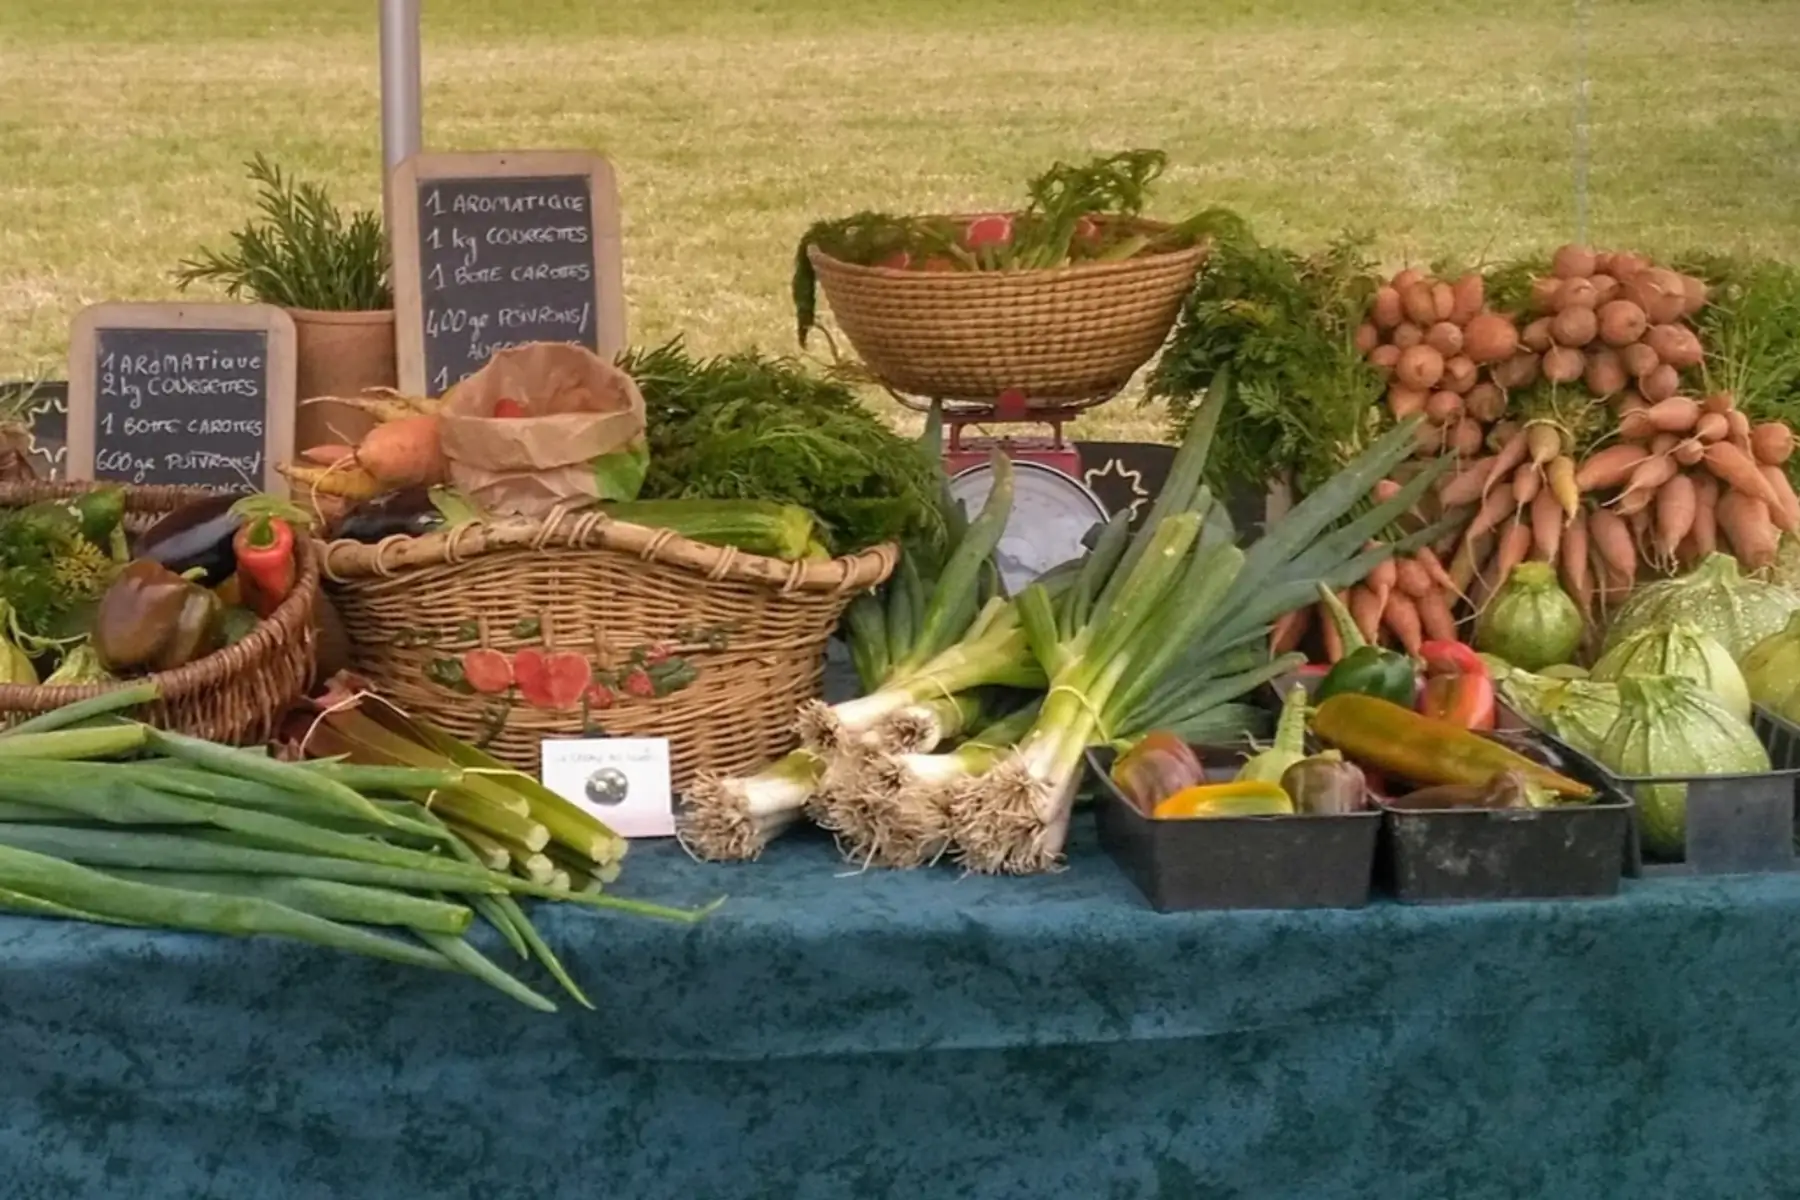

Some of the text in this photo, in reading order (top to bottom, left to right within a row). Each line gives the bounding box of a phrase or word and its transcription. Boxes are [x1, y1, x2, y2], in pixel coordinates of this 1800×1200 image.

[425, 189, 585, 216] 1 AROMATIQUE
[426, 225, 589, 267] 1 kg COURGETTES
[428, 263, 591, 290] 1 BOTTE CAROTTES
[100, 351, 115, 371] 1
[147, 376, 259, 397] COURGETTES
[433, 366, 449, 392] 1
[100, 412, 263, 437] 1 BOTTE CAROTTES
